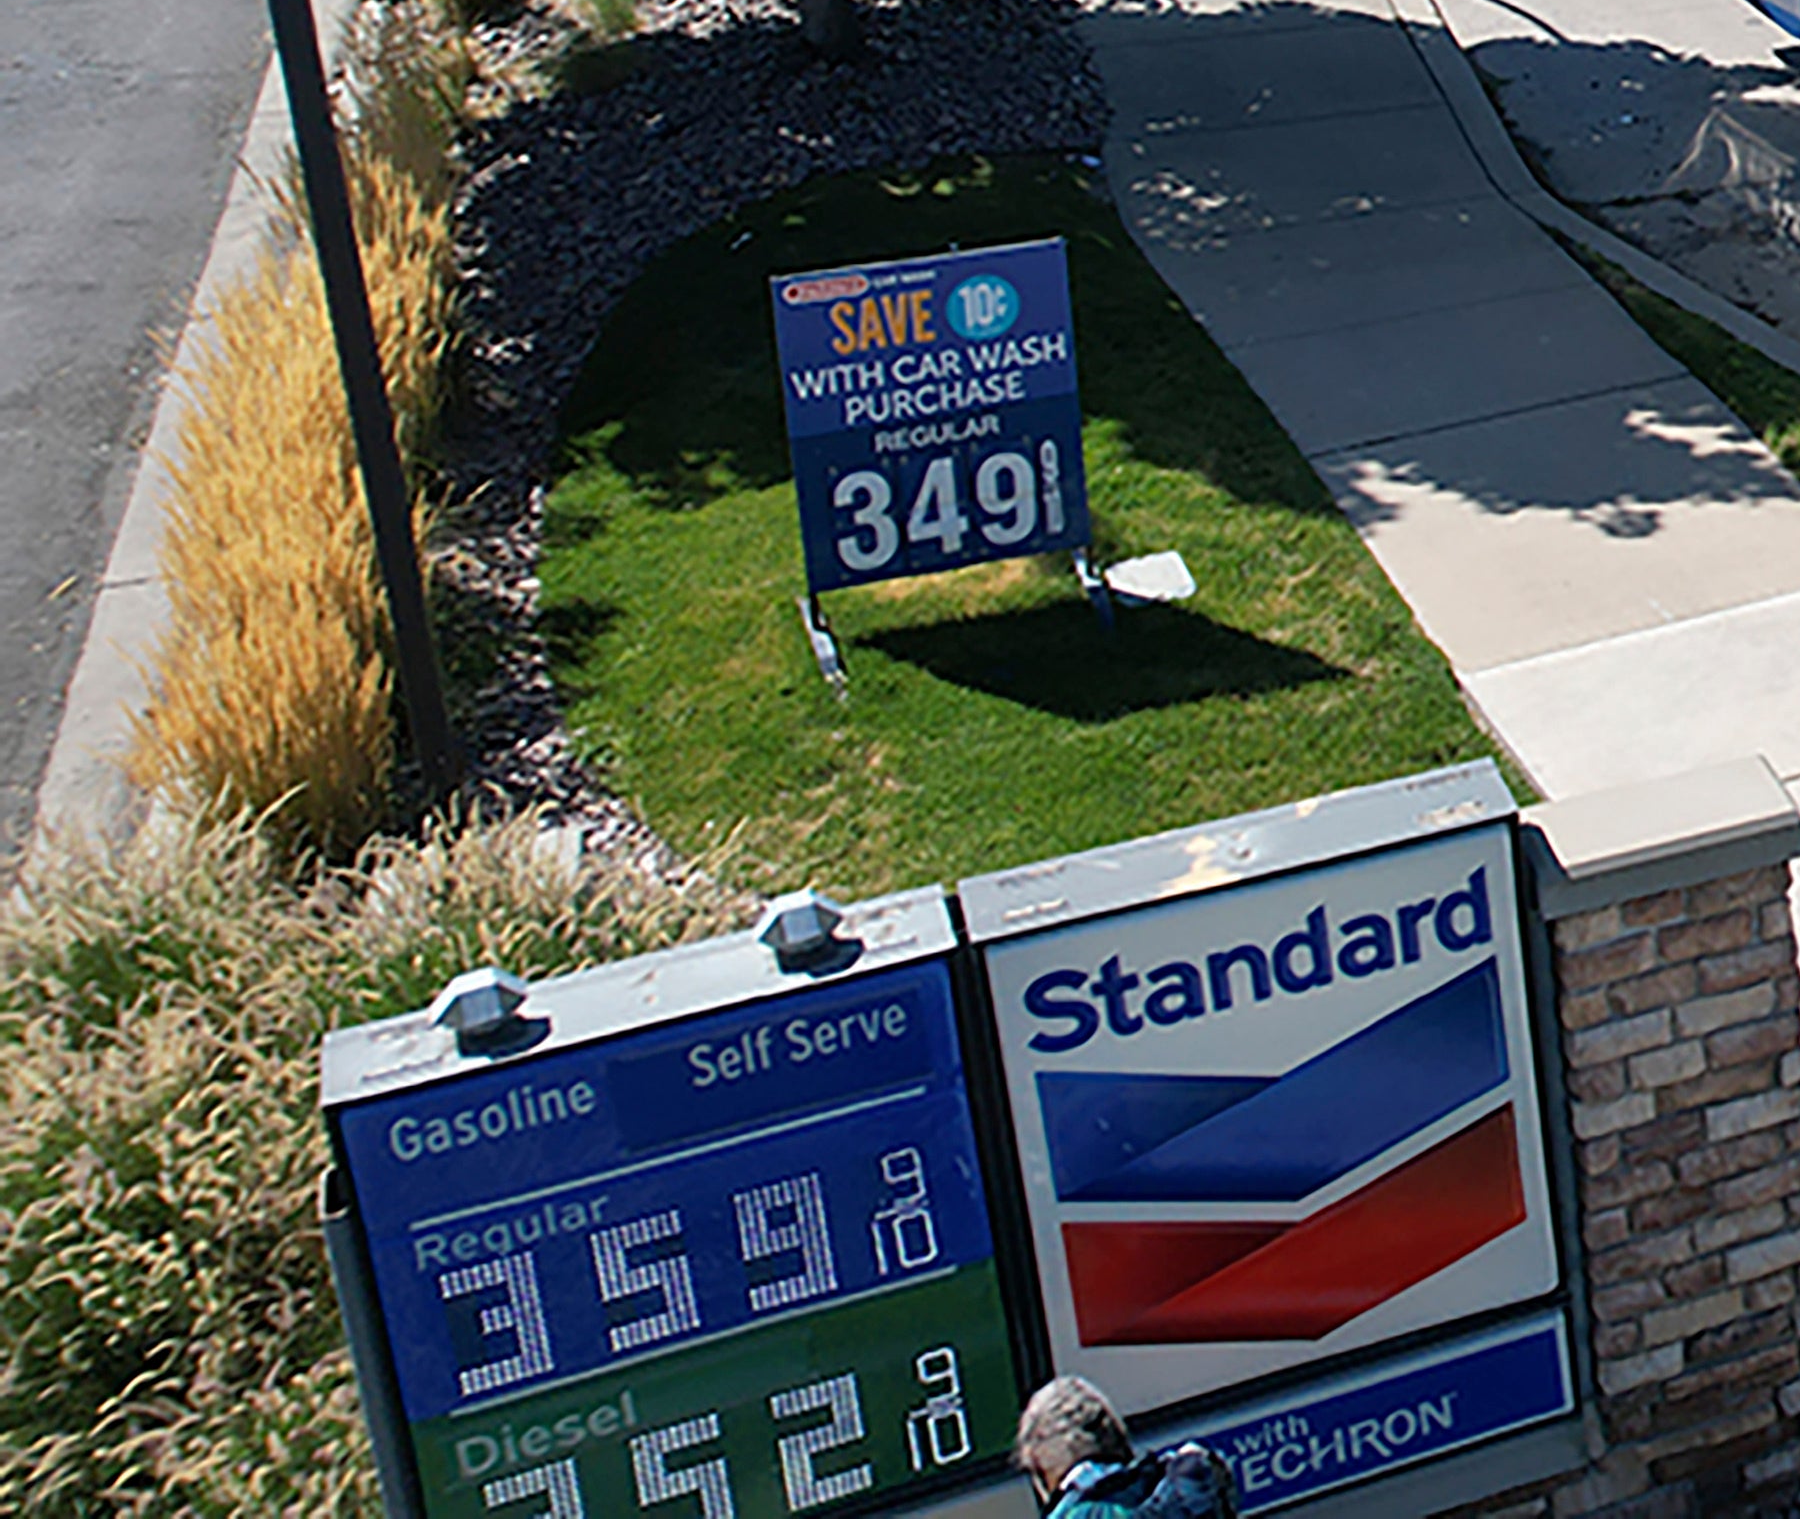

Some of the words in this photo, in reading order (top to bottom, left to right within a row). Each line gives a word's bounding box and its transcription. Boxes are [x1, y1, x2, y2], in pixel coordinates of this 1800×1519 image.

[829, 289, 937, 354] SAVE
[790, 362, 885, 400] WITH
[891, 352, 961, 385] CAR
[966, 332, 1067, 371] WASH
[845, 370, 1027, 425] PURCHASE
[874, 413, 1000, 454] REGULAR
[833, 452, 1037, 572] 349
[1024, 866, 1494, 1052] Standard
[389, 1081, 597, 1161] Gasoline
[688, 1024, 772, 1087] Self
[784, 1002, 907, 1061] Serve
[413, 1193, 610, 1272] Regular
[438, 1172, 838, 1397] 359
[454, 1389, 637, 1478] Diesel
[1226, 1392, 1459, 1493] ECHRON
[1232, 1413, 1309, 1456] with
